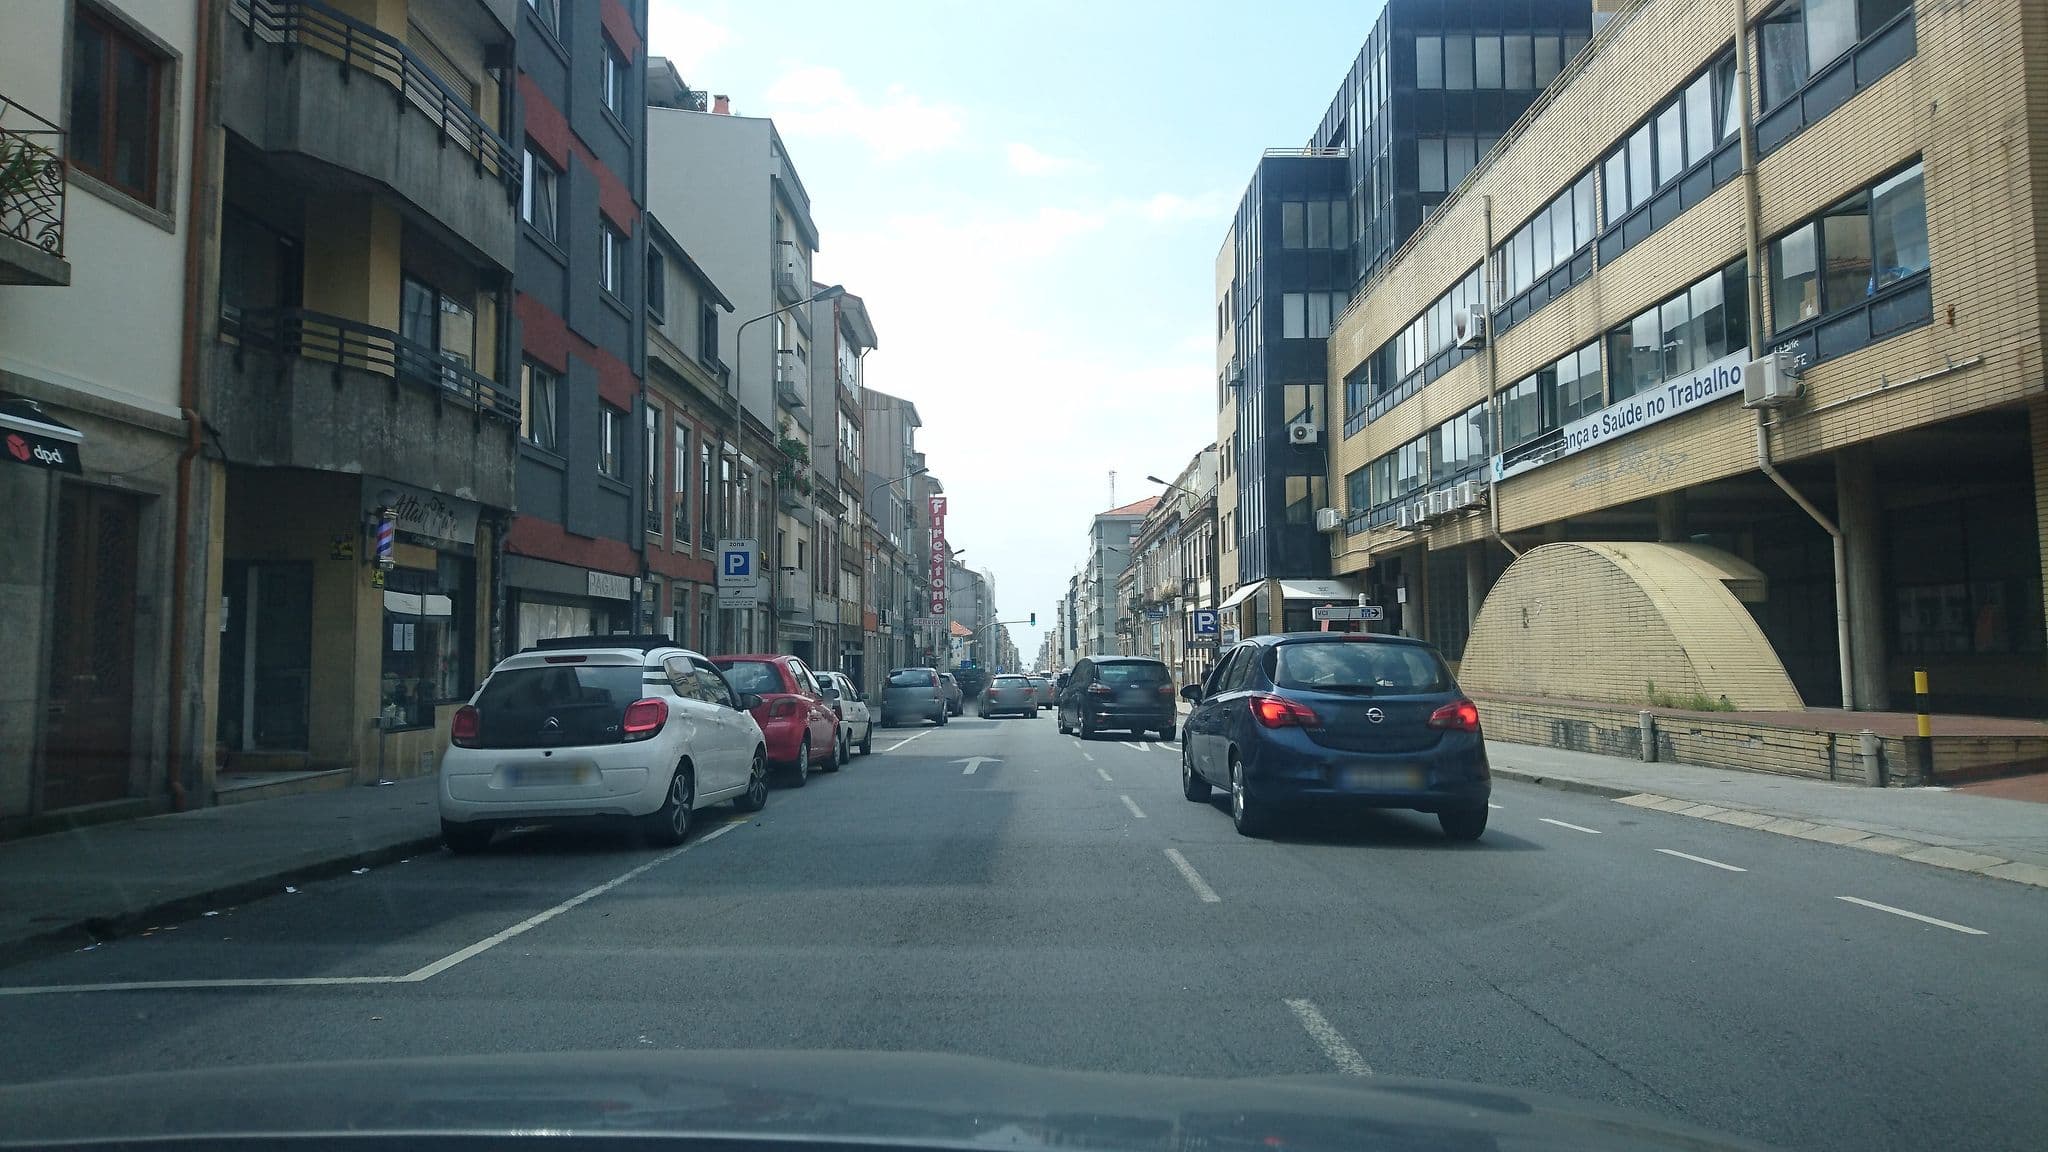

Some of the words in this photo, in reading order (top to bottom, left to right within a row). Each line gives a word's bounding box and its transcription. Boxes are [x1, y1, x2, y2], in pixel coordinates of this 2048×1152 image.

[1592, 424, 1599, 439] e
[1602, 403, 1643, 435] Saúde
[1646, 397, 1665, 418] no
[1668, 364, 1741, 409] Trabalho
[33, 445, 63, 464] dpd
[729, 554, 745, 574] P
[932, 499, 945, 613] Firestone
